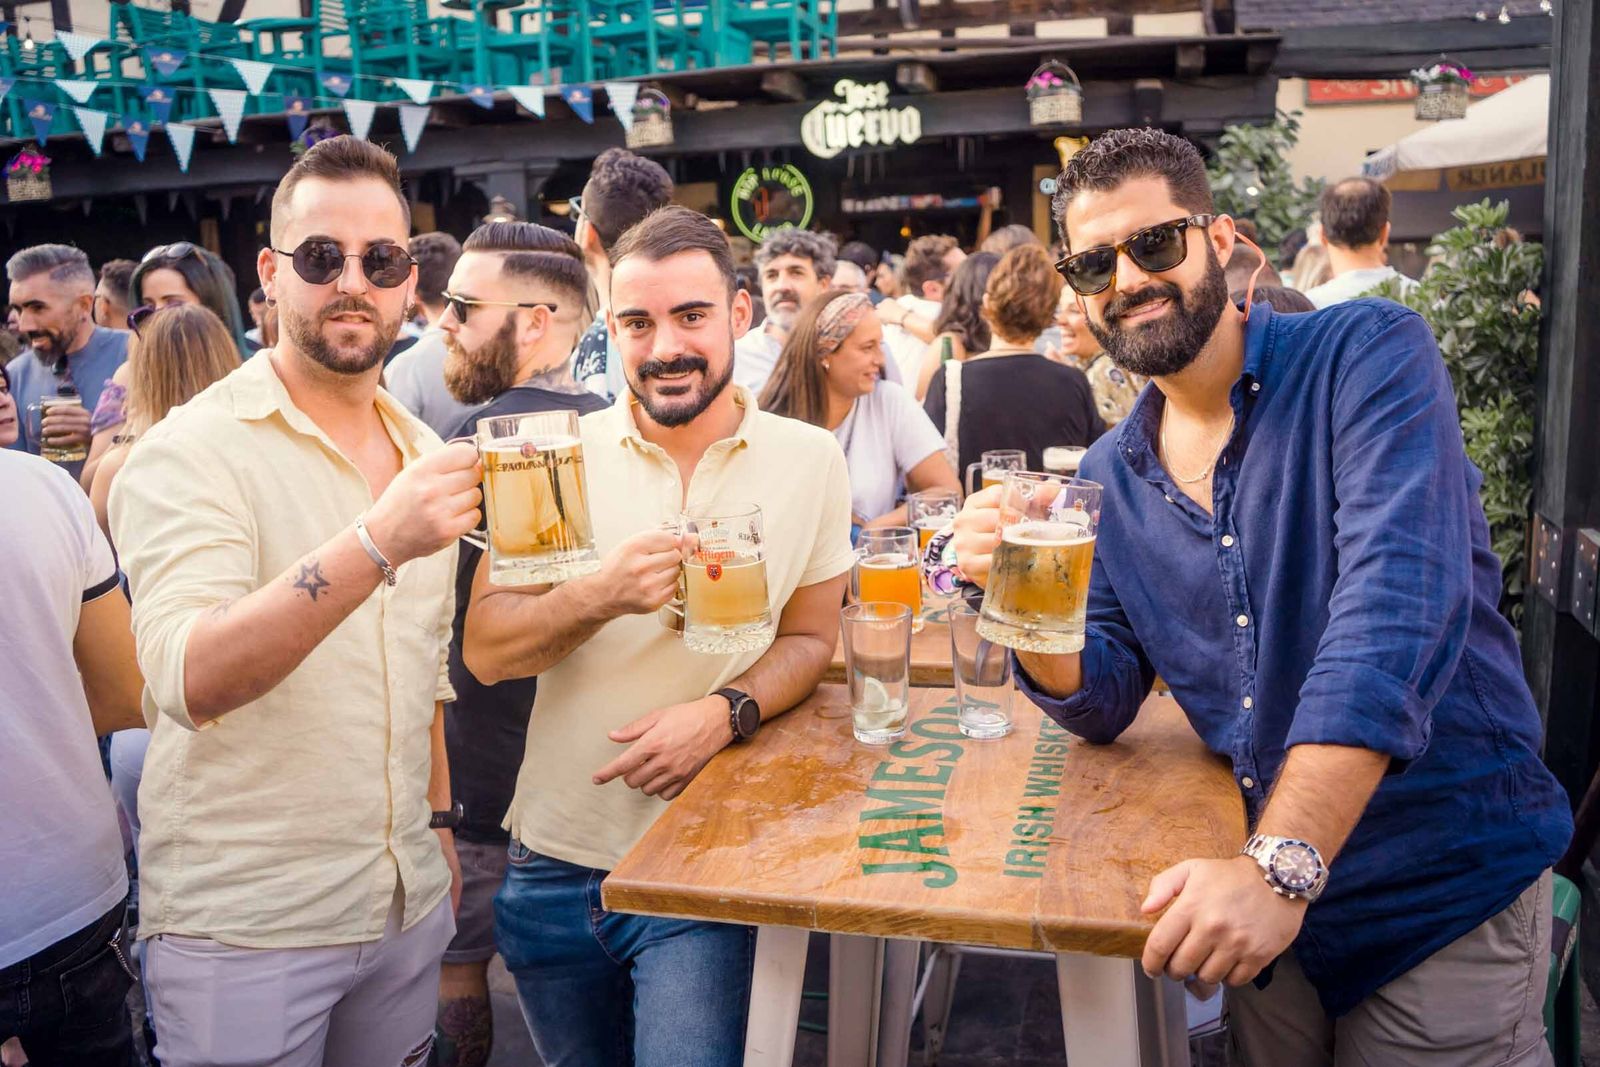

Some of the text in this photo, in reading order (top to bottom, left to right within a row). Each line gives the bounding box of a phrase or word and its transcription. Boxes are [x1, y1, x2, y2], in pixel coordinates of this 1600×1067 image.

[800, 99, 922, 160] Cuervo
[1002, 715, 1071, 879] IRISH WHISKE
